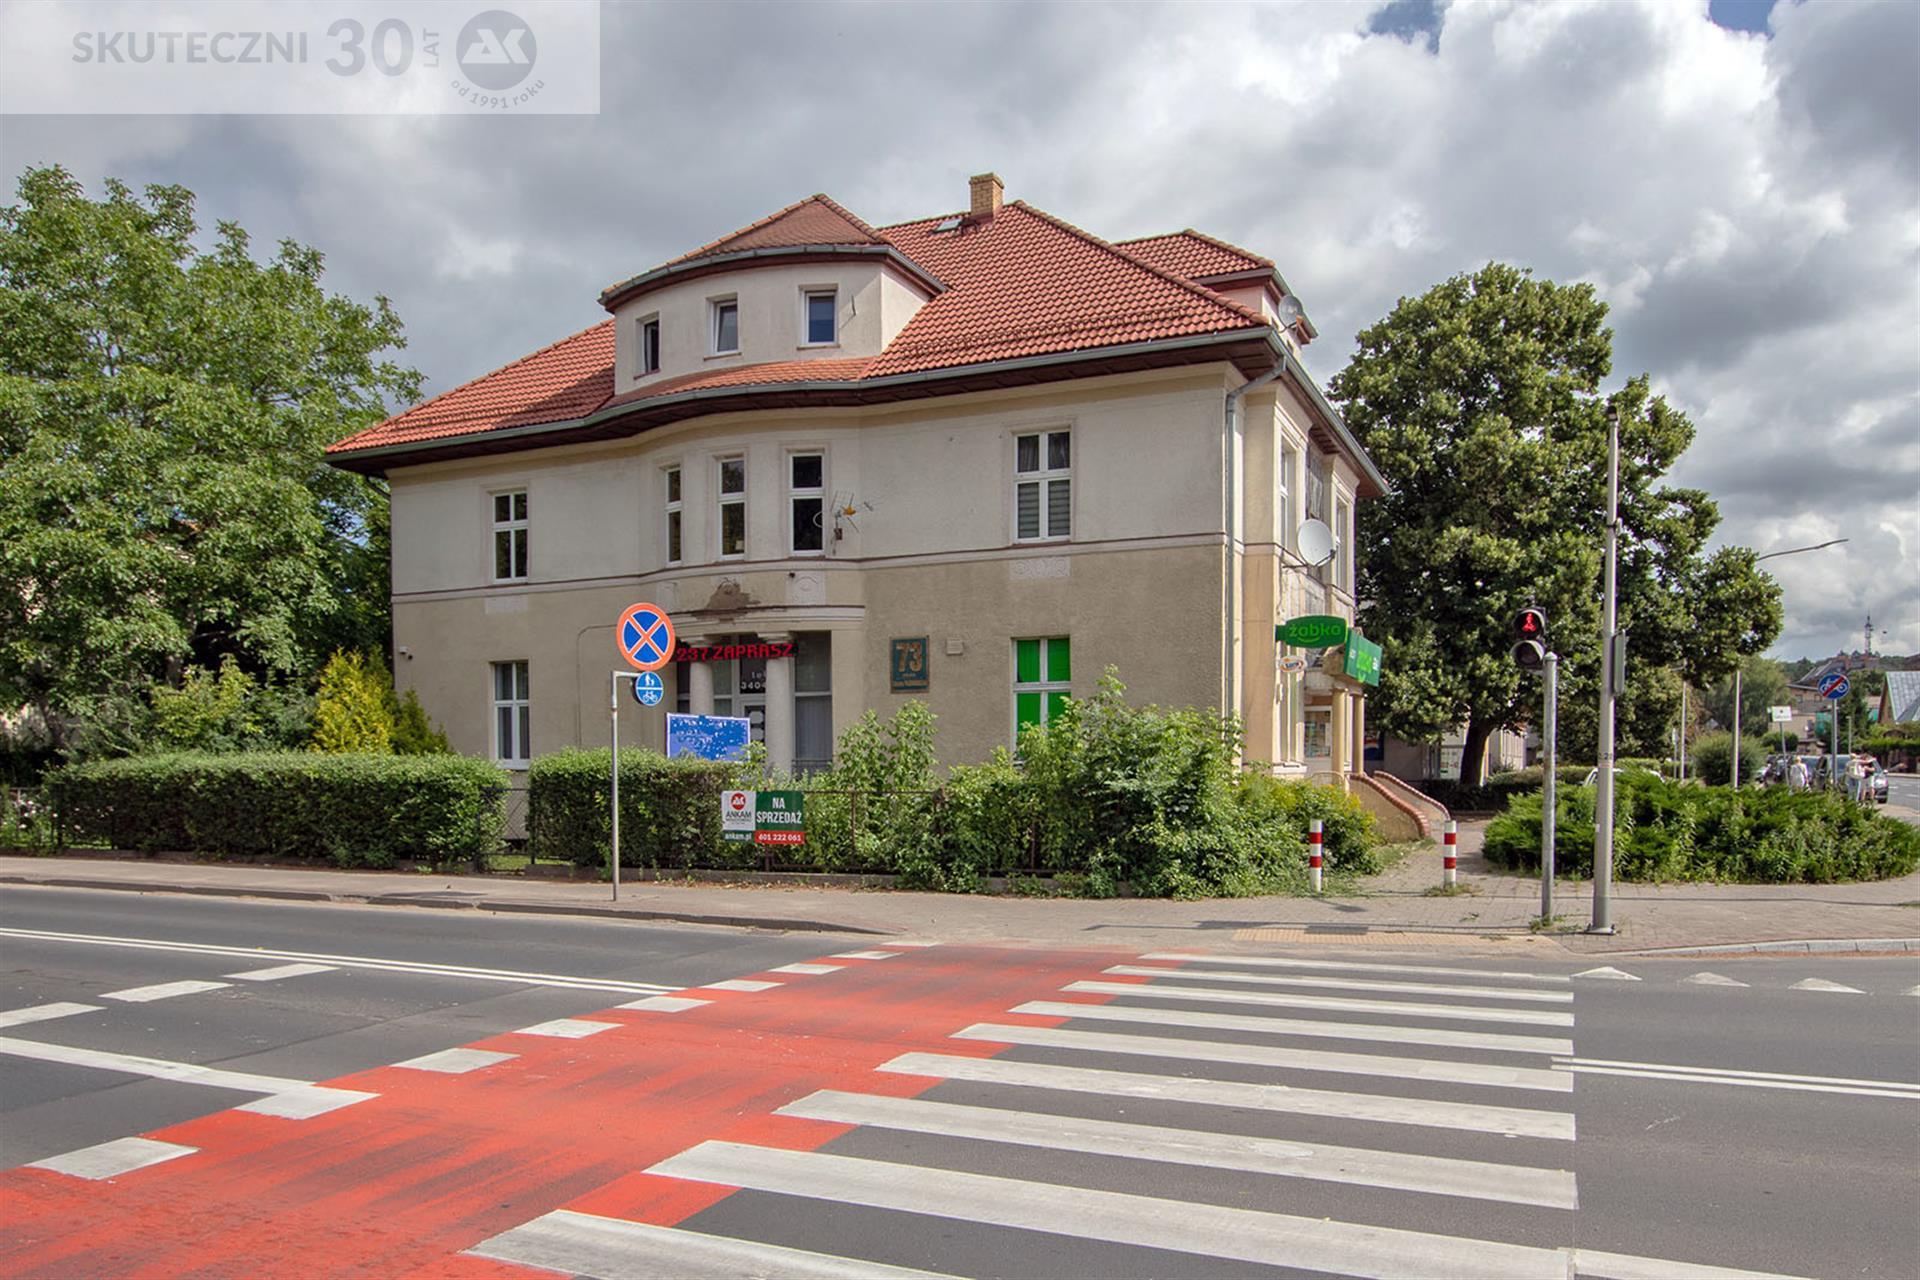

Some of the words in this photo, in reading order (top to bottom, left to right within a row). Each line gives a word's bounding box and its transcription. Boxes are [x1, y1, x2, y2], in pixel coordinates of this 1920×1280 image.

[1289, 624, 1340, 637] żabka
[772, 797, 785, 809] NA
[756, 810, 802, 824] SPRZEDAŻ
